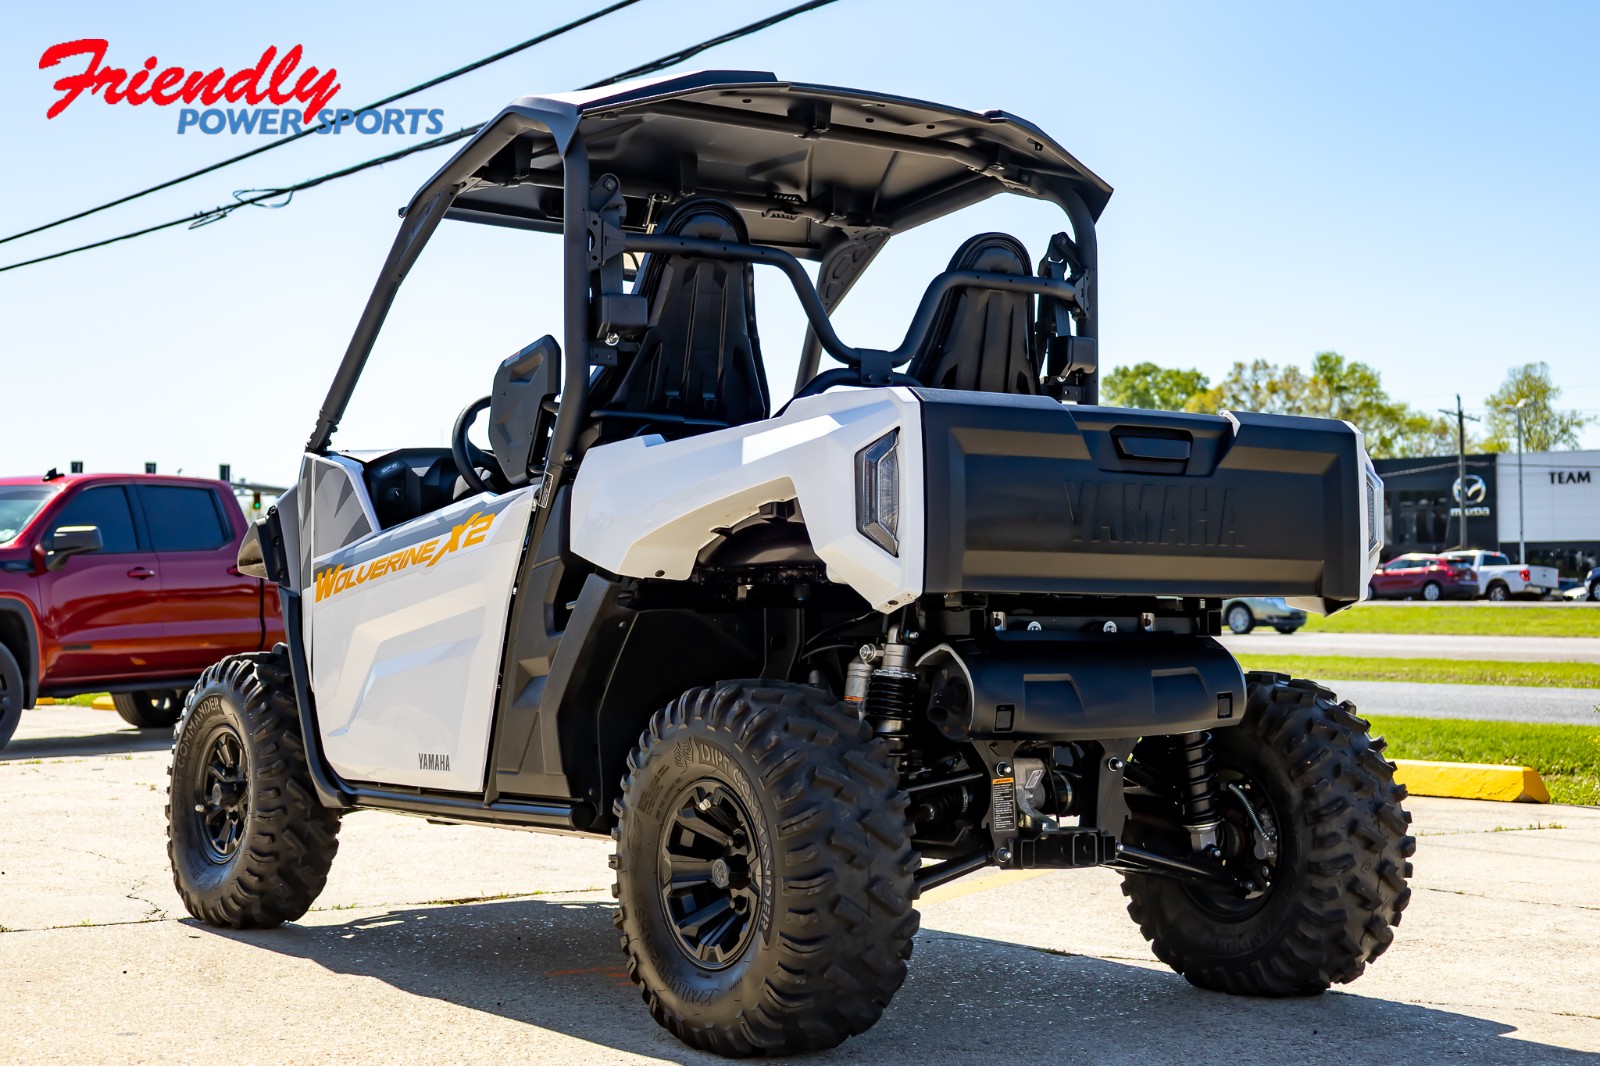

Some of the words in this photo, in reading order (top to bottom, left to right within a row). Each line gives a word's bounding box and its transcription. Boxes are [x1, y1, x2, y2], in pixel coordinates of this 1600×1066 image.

[1549, 471, 1591, 484] TEAM
[426, 510, 495, 568] X2
[1063, 480, 1245, 548] YAMAHA
[177, 697, 221, 767] COMMANDER
[418, 753, 451, 771] YAMAHA
[700, 743, 731, 773] DIRT
[733, 768, 772, 930] COMMANDER
